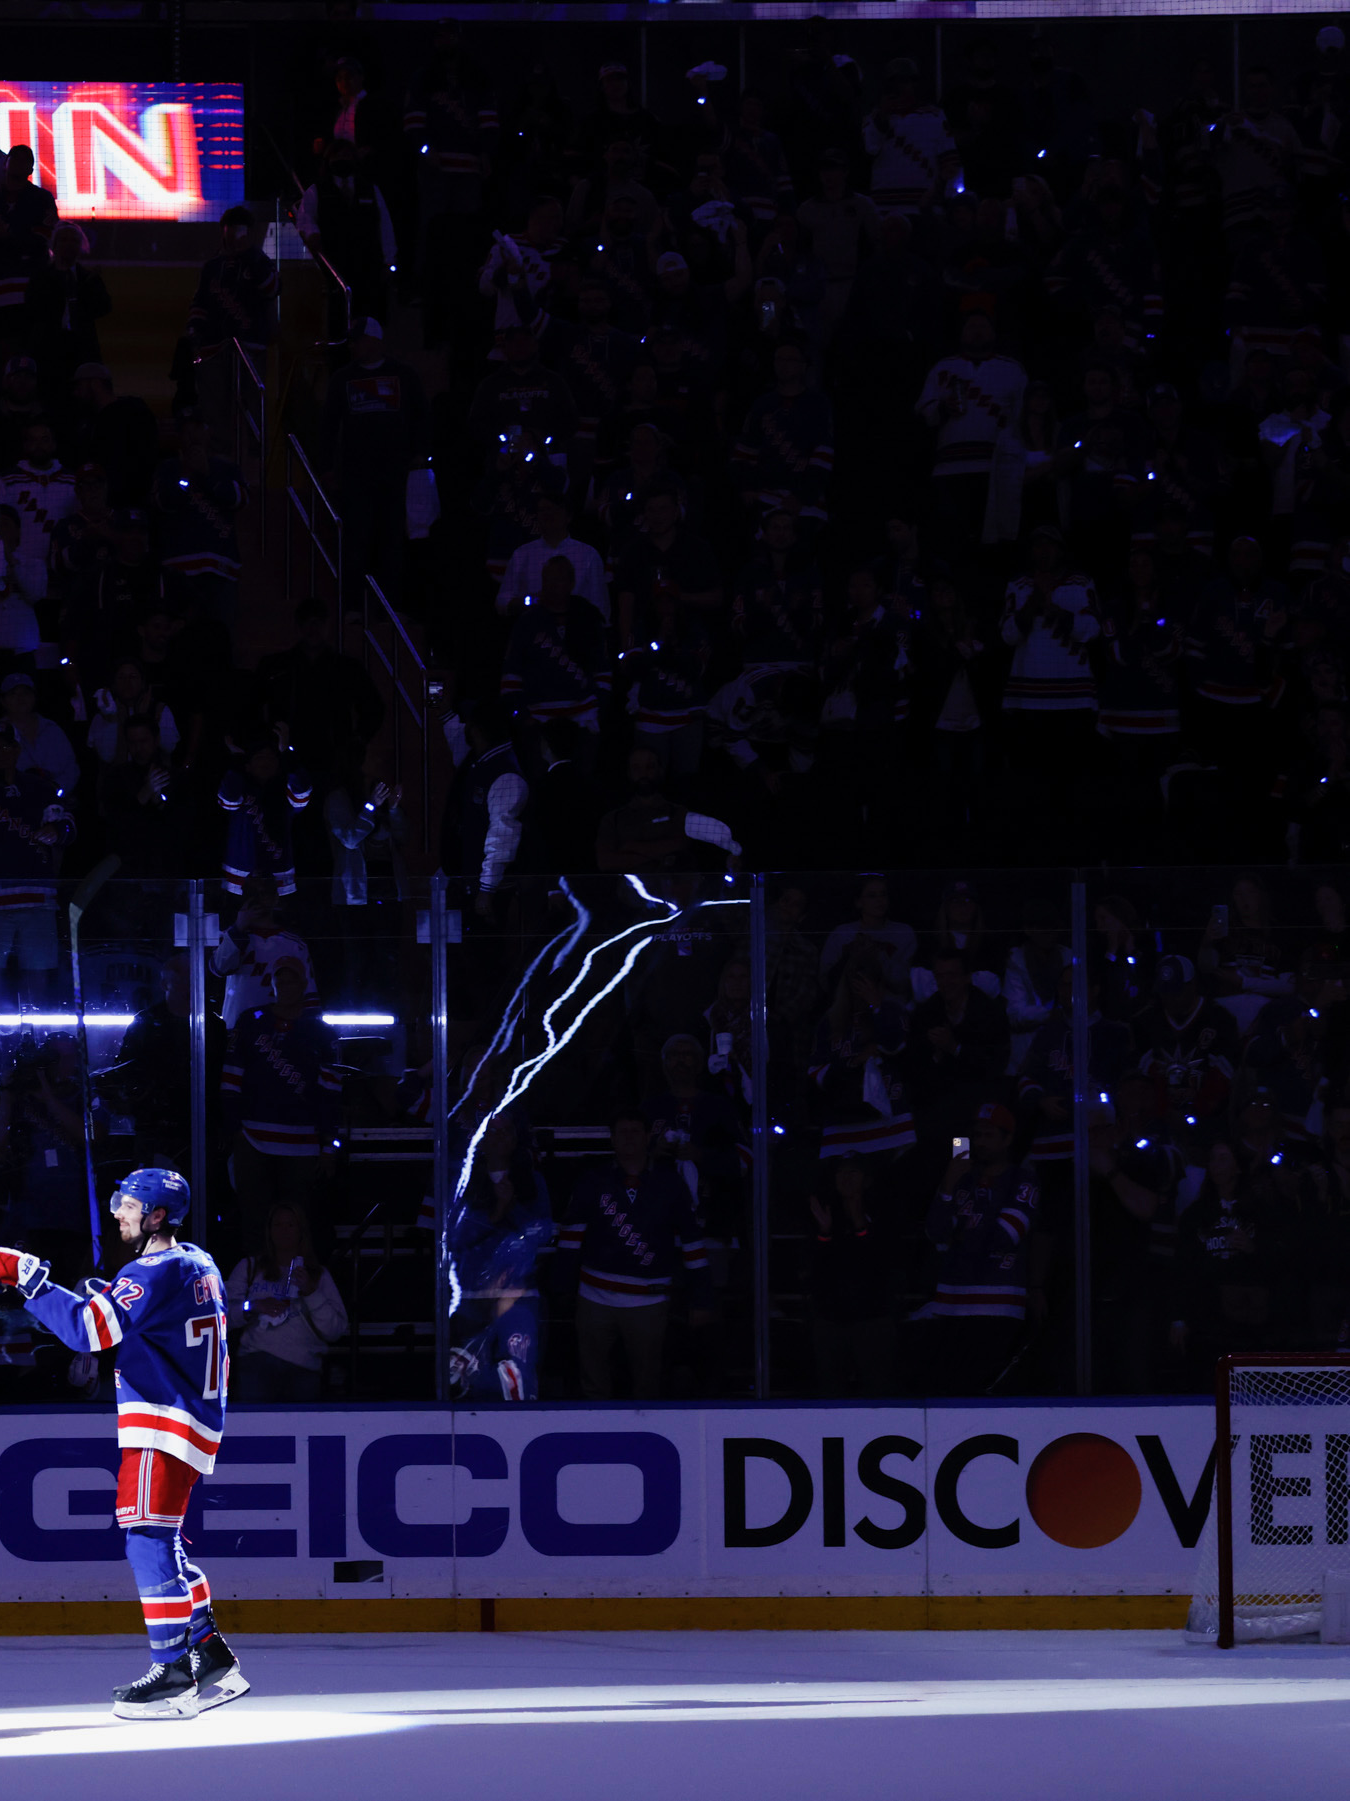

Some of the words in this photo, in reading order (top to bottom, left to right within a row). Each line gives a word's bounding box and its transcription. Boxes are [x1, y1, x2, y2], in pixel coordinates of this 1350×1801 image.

[254, 1033, 307, 1095] RANGERS
[600, 1193, 656, 1266] RANGERS
[112, 1277, 145, 1311] 72
[723, 1432, 1350, 1550] DISCOVE
